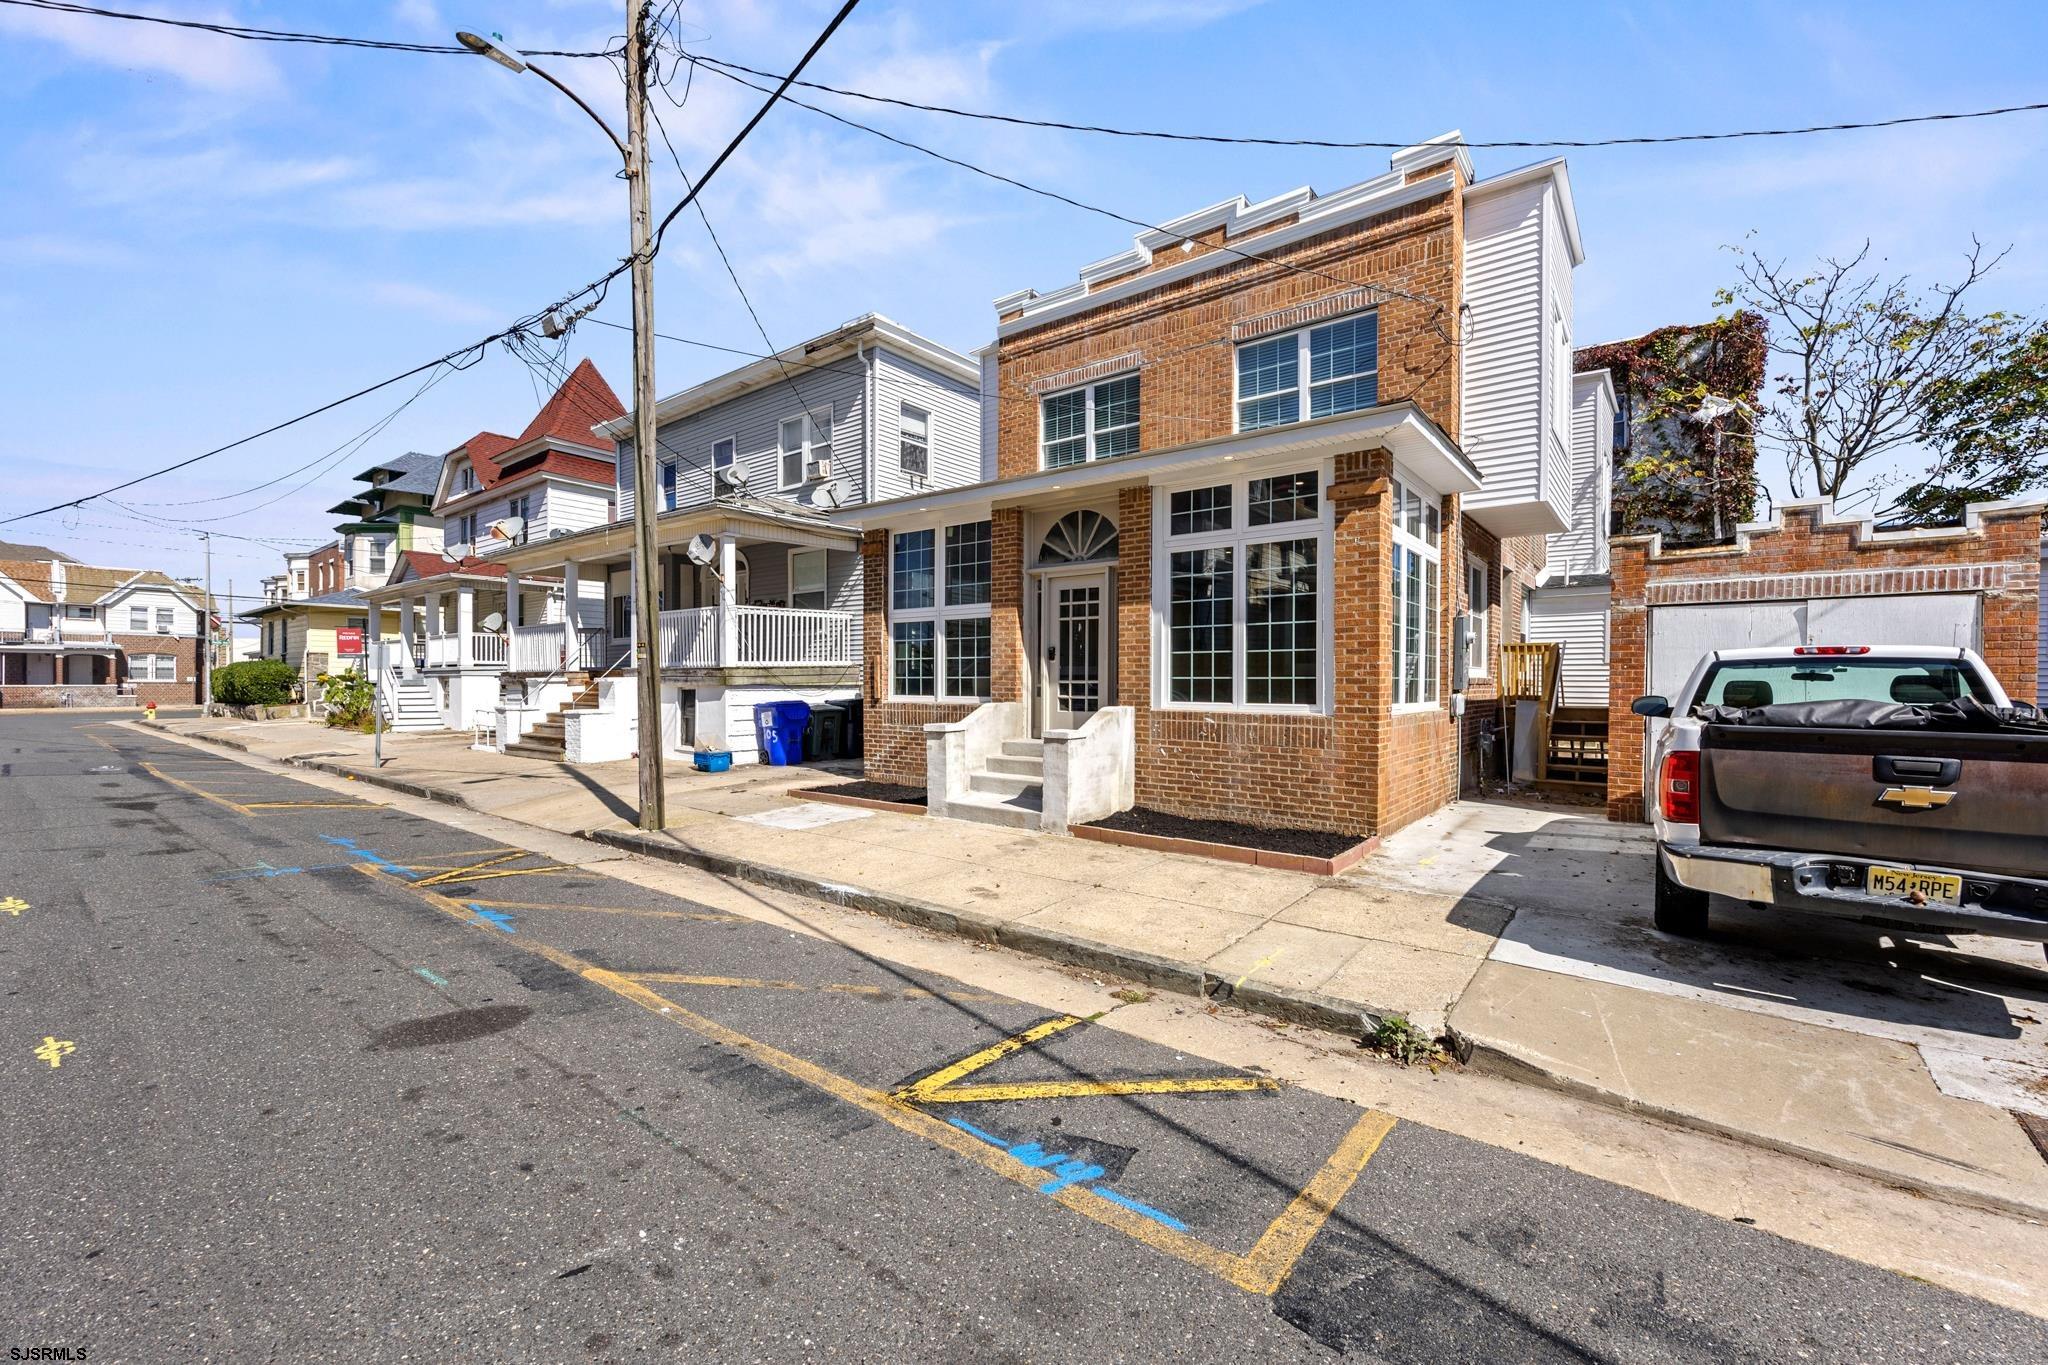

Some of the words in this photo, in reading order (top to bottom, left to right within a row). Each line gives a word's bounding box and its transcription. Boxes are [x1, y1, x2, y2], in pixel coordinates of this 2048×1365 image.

[1912, 872, 1938, 881] Jersey
[1873, 874, 1906, 893] M54
[1920, 880, 1954, 899] RPE
